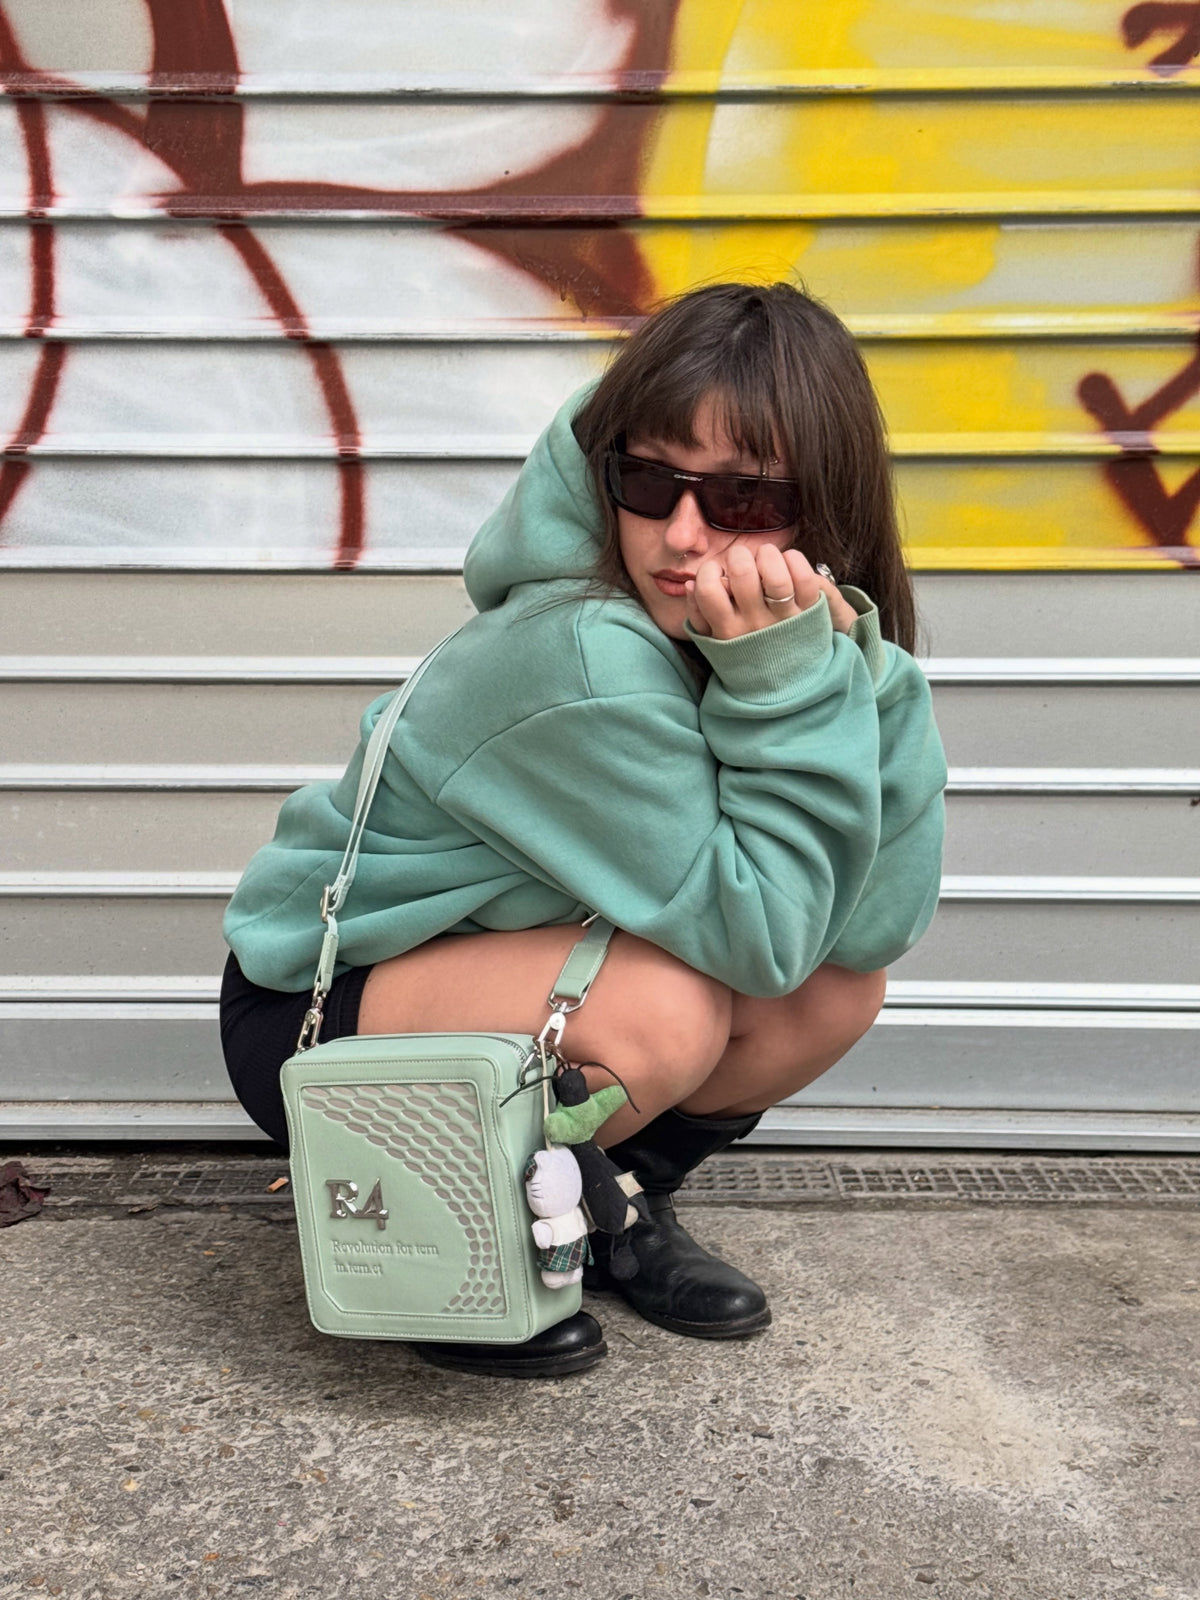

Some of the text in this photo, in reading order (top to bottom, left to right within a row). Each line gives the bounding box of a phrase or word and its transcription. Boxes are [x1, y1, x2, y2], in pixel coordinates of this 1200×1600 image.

[325, 1177, 389, 1231] R4
[331, 1239, 393, 1255] Revolution
[396, 1240, 413, 1255] for
